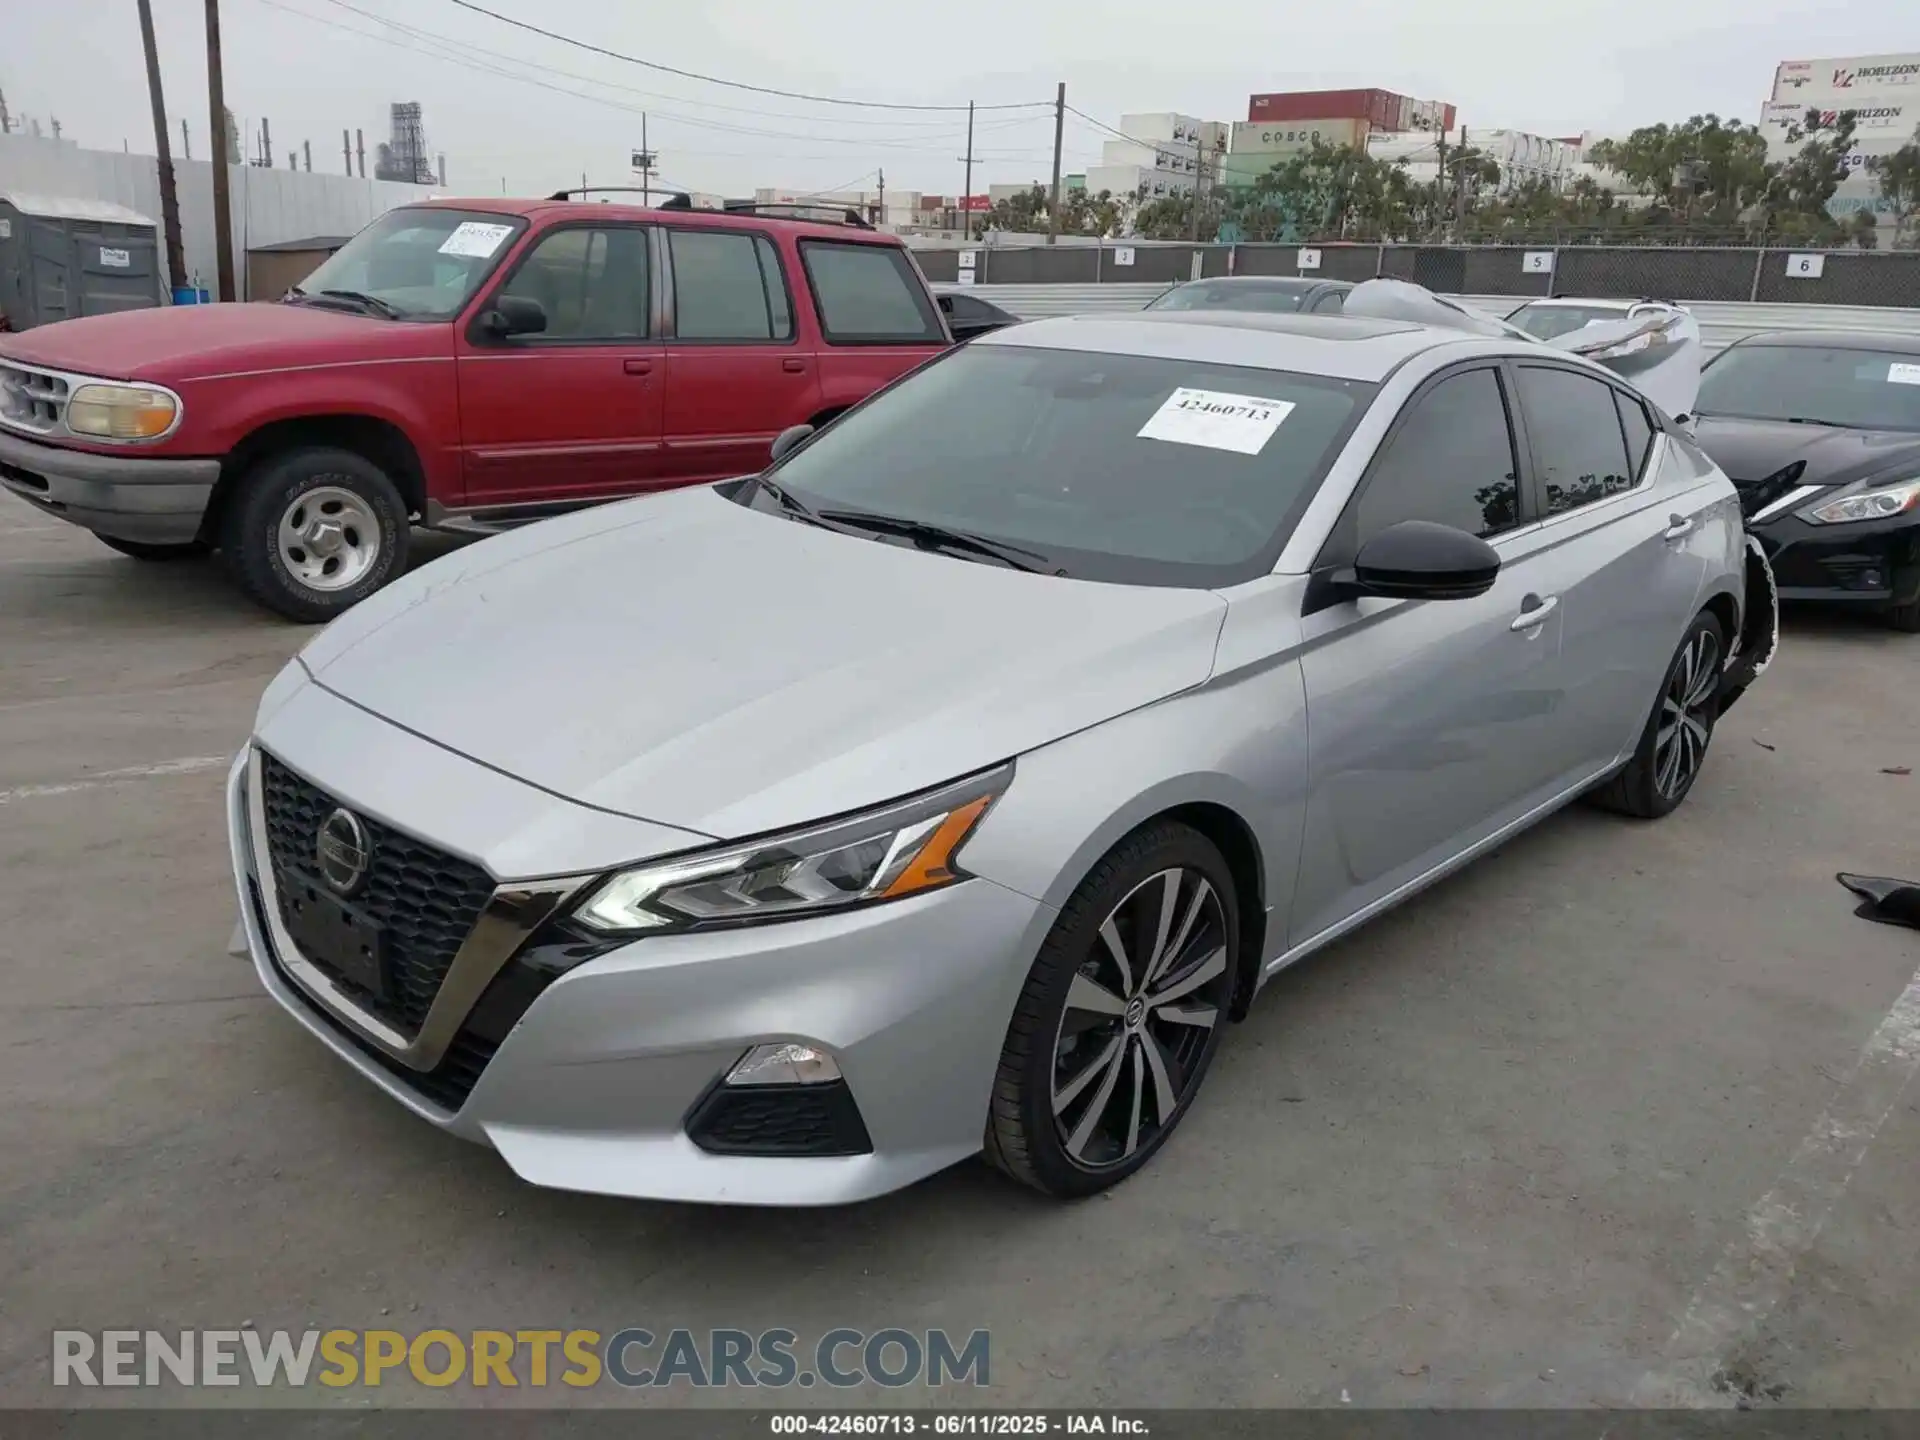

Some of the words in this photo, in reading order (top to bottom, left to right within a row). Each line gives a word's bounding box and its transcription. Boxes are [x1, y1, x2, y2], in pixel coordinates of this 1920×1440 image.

[1857, 64, 1920, 77] HORIZON
[1262, 131, 1321, 143] COSCO
[1534, 256, 1542, 268] 5
[1800, 259, 1810, 272] 6
[1176, 399, 1270, 421] 42460713
